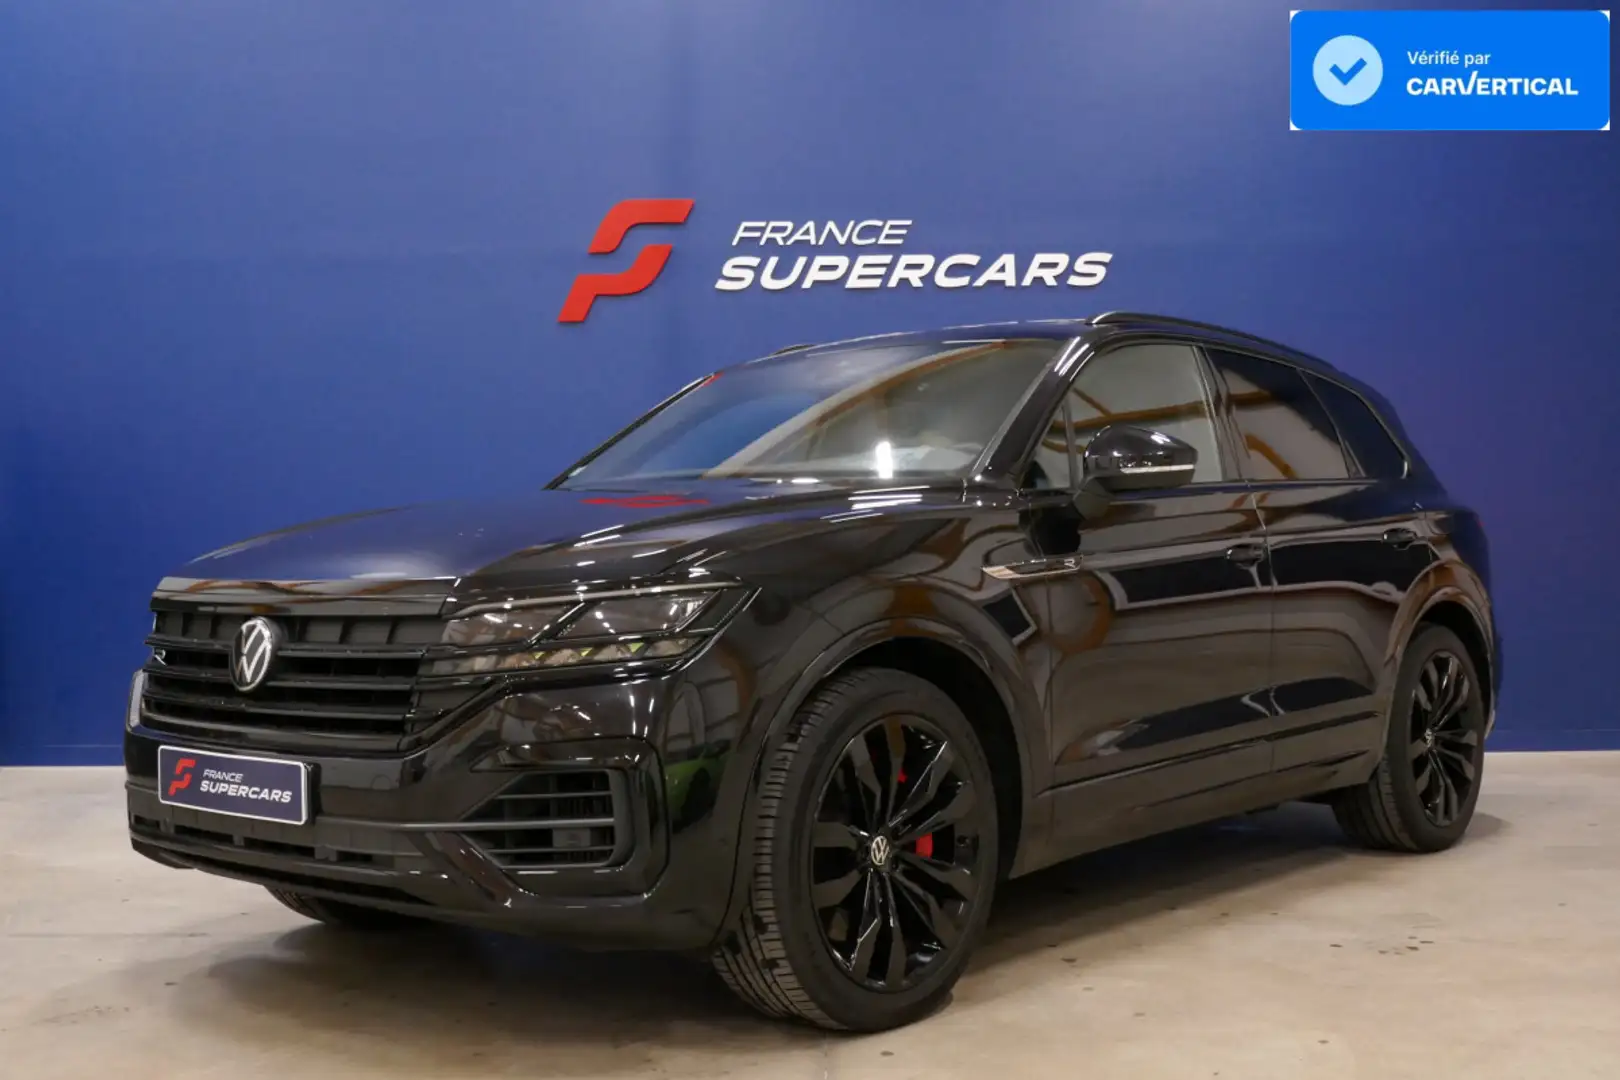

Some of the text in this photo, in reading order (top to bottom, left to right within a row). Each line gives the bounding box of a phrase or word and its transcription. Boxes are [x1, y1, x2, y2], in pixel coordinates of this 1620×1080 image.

[731, 219, 913, 246] FRANCE
[714, 252, 1114, 291] SUPERCARS
[202, 768, 244, 783] FRANCE
[199, 780, 293, 803] SUPERCARS
